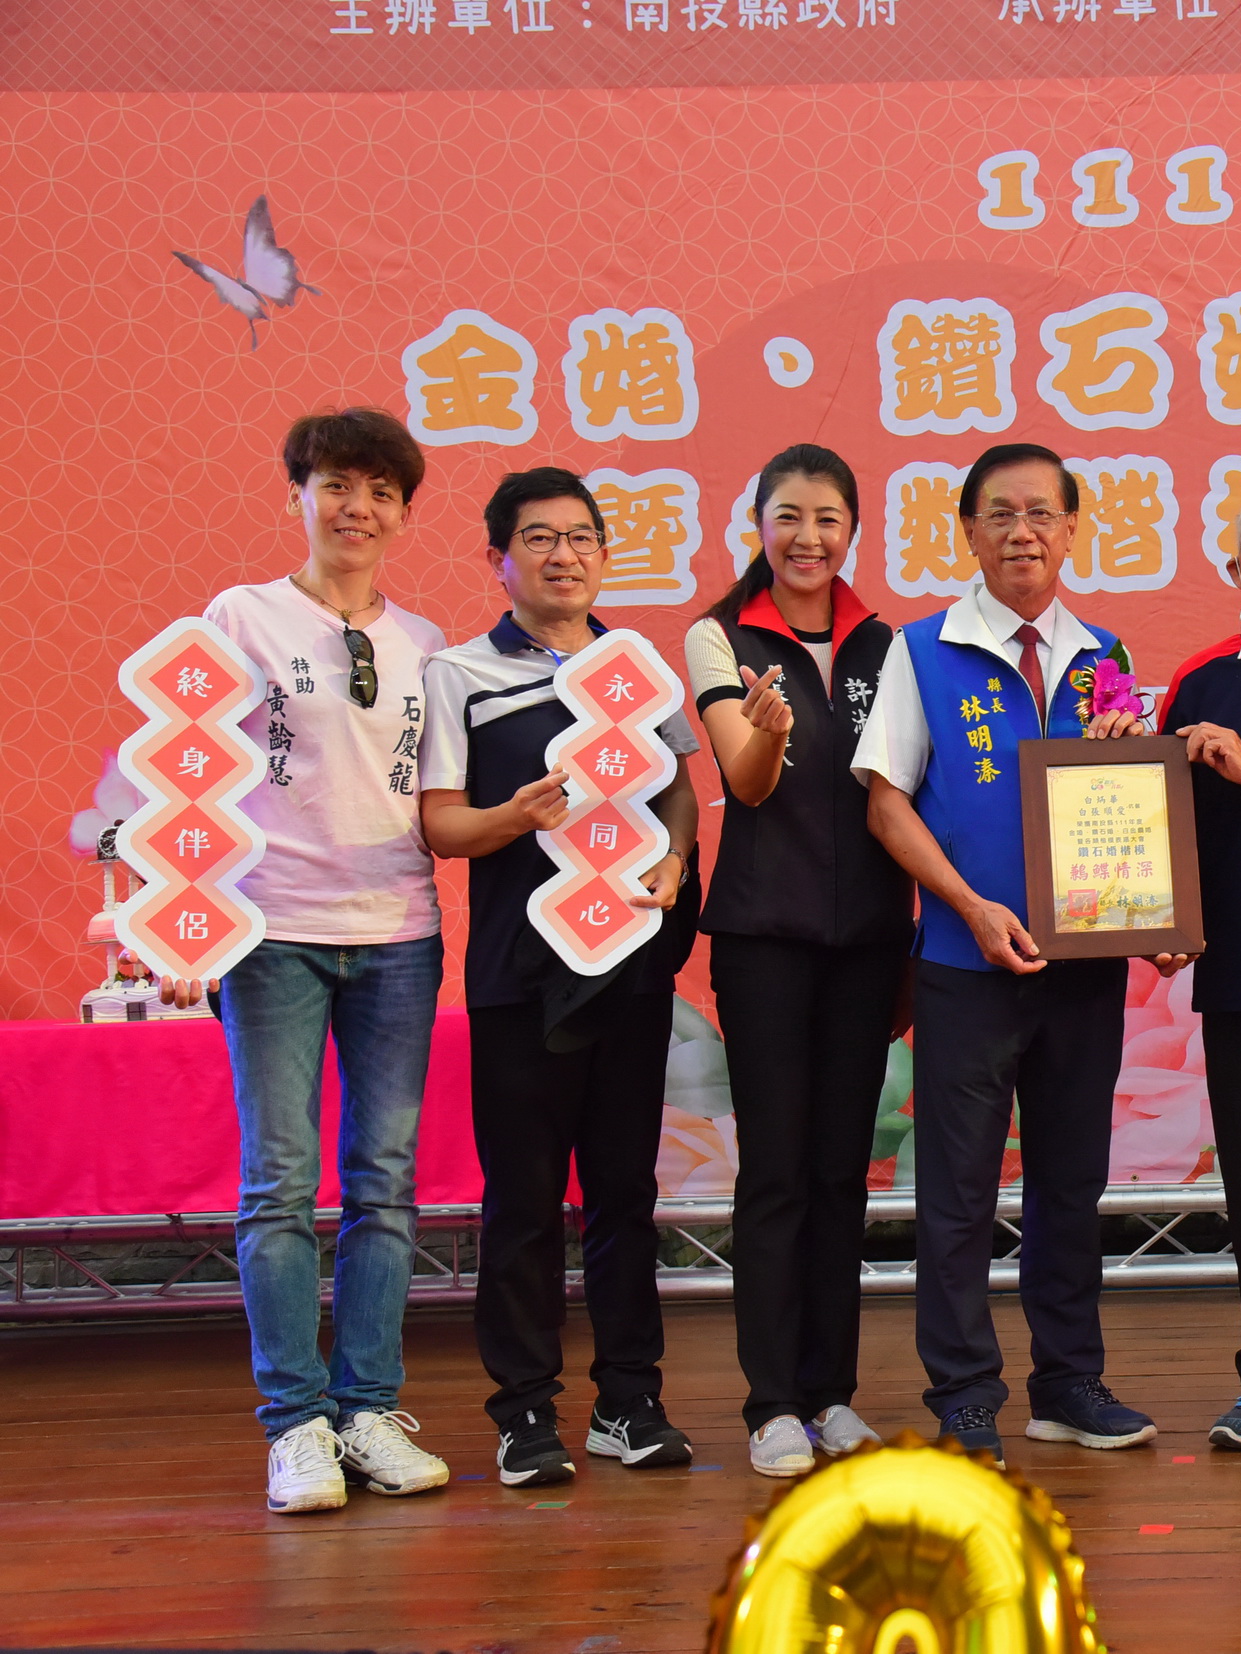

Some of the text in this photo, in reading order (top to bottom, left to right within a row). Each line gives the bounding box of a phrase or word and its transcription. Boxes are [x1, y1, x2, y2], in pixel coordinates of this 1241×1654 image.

[291, 656, 315, 694] 特助
[986, 677, 1007, 714] 縣長
[266, 685, 296, 787] 黃齡慧
[388, 696, 422, 796] 石慶龍
[959, 695, 1002, 785] 林明溱
[174, 666, 213, 940] 終身伴侶
[578, 673, 635, 926] 永結同心
